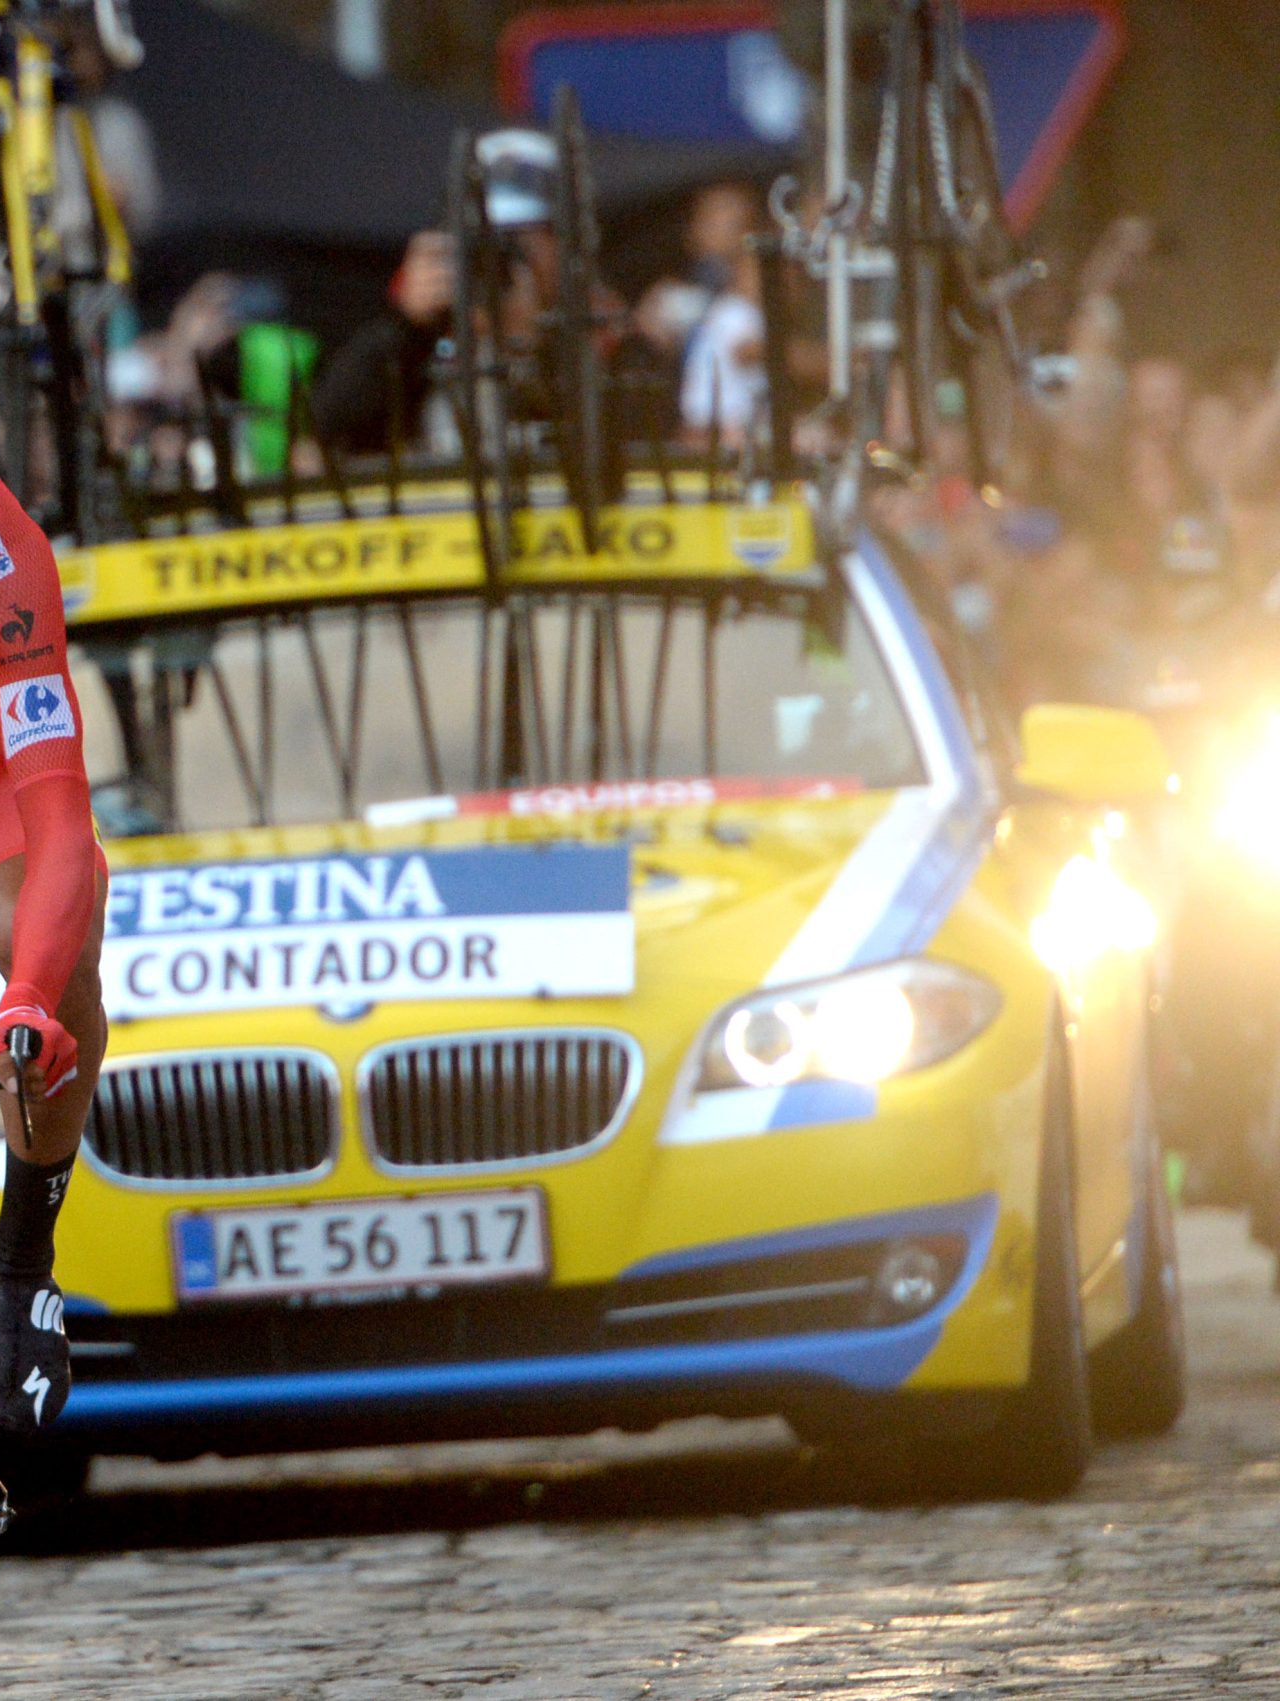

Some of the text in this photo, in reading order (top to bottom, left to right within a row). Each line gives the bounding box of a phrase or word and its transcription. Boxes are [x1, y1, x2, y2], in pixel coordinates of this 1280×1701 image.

[147, 531, 432, 592] TINKOFF
[8, 722, 67, 747] Carrefour
[106, 856, 446, 935] FESTINA
[127, 935, 497, 998] CONTADOR
[226, 1205, 527, 1278] AE 56 117
